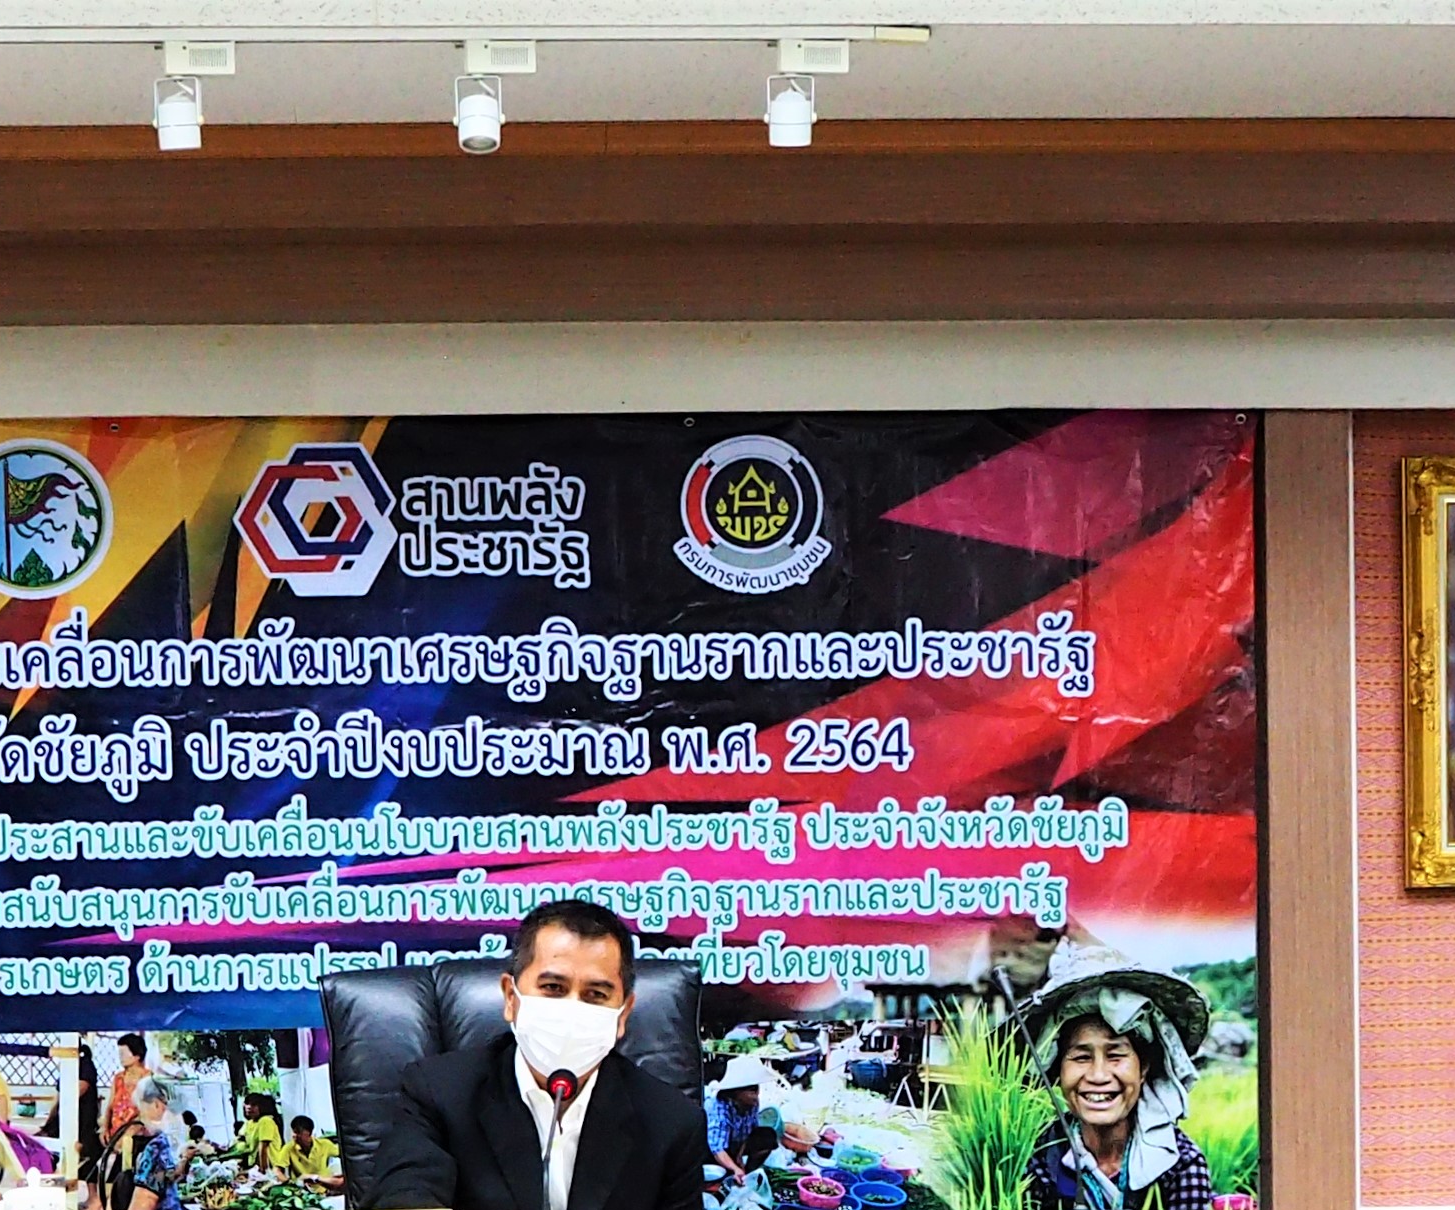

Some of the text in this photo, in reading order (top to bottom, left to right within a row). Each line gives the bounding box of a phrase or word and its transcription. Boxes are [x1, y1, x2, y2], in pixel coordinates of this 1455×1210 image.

[404, 465, 583, 517] สานพลัง
[404, 521, 587, 583] ประชารัฐ
[677, 540, 827, 590] กรมการพัฒนาชุมชน
[191, 713, 646, 778] ประจำปีงบประมาณ
[669, 723, 766, 770] พ.ศ.
[789, 720, 911, 770] 2564
[808, 800, 1125, 857] ประจำจังหวัดชัยภูมิ
